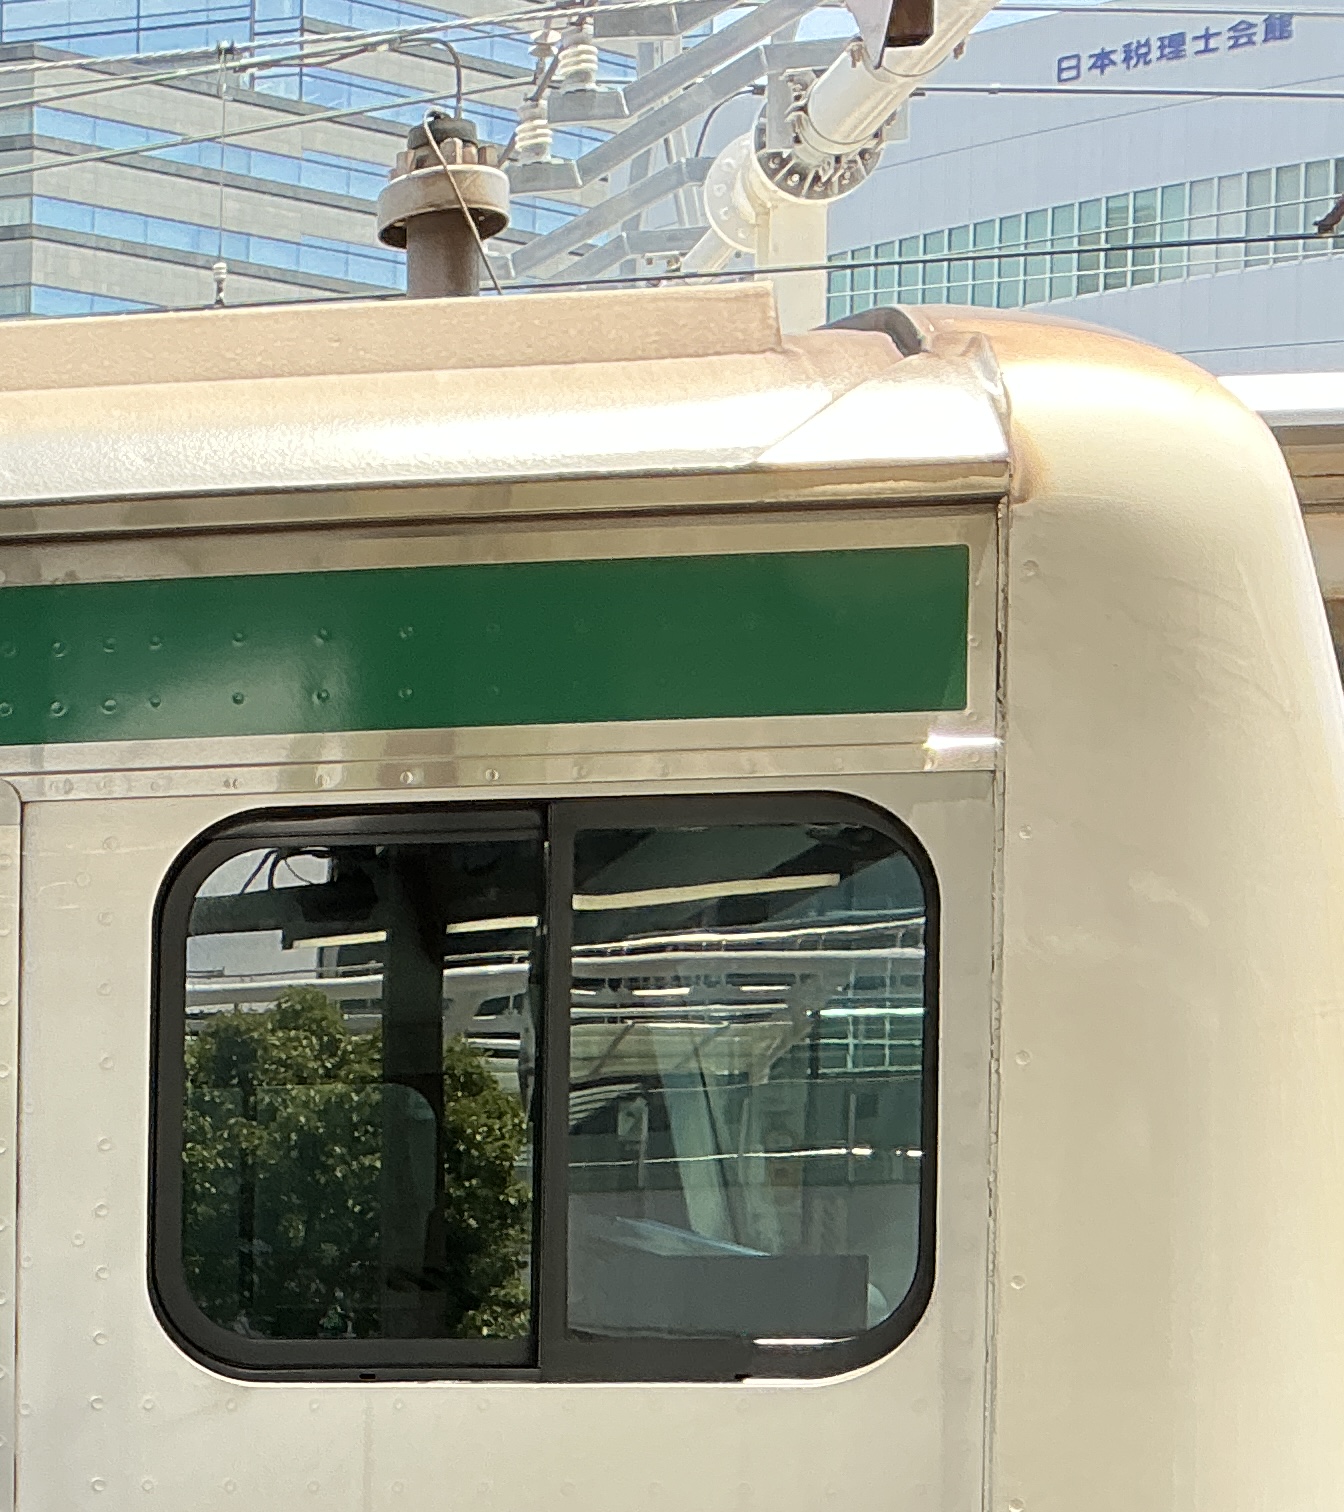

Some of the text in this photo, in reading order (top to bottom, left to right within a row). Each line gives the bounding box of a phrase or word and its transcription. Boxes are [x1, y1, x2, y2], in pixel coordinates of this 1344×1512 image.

[1056, 13, 1295, 83] 日本税理士会館
